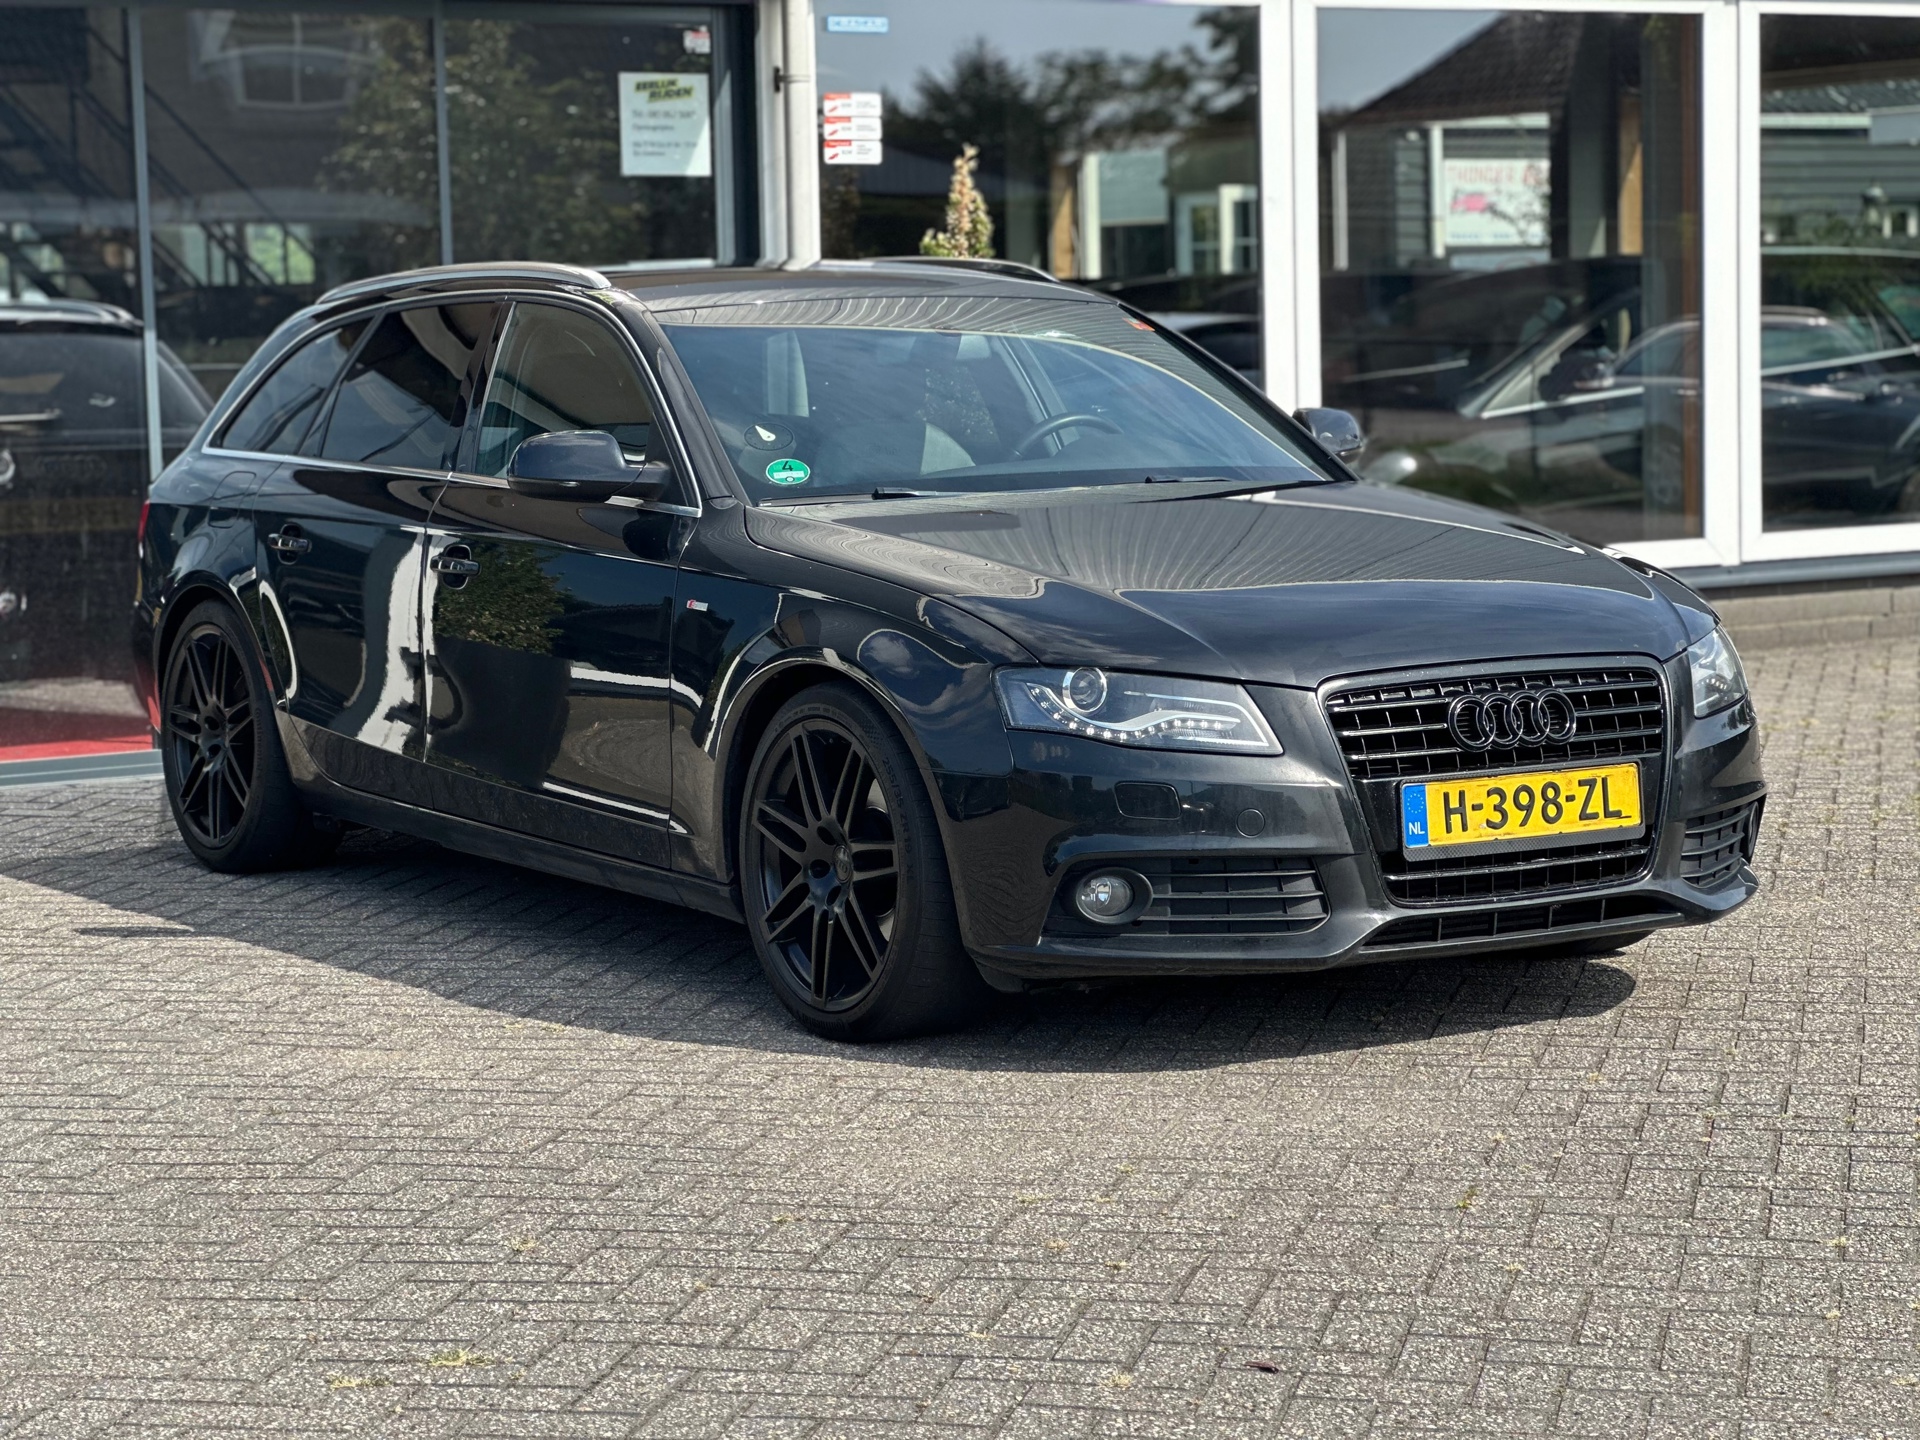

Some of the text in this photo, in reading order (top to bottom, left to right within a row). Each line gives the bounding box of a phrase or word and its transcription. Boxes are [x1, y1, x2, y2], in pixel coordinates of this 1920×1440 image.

[781, 460, 794, 472] 4
[1443, 776, 1623, 834] H-398-ZL
[1408, 821, 1426, 836] NL
